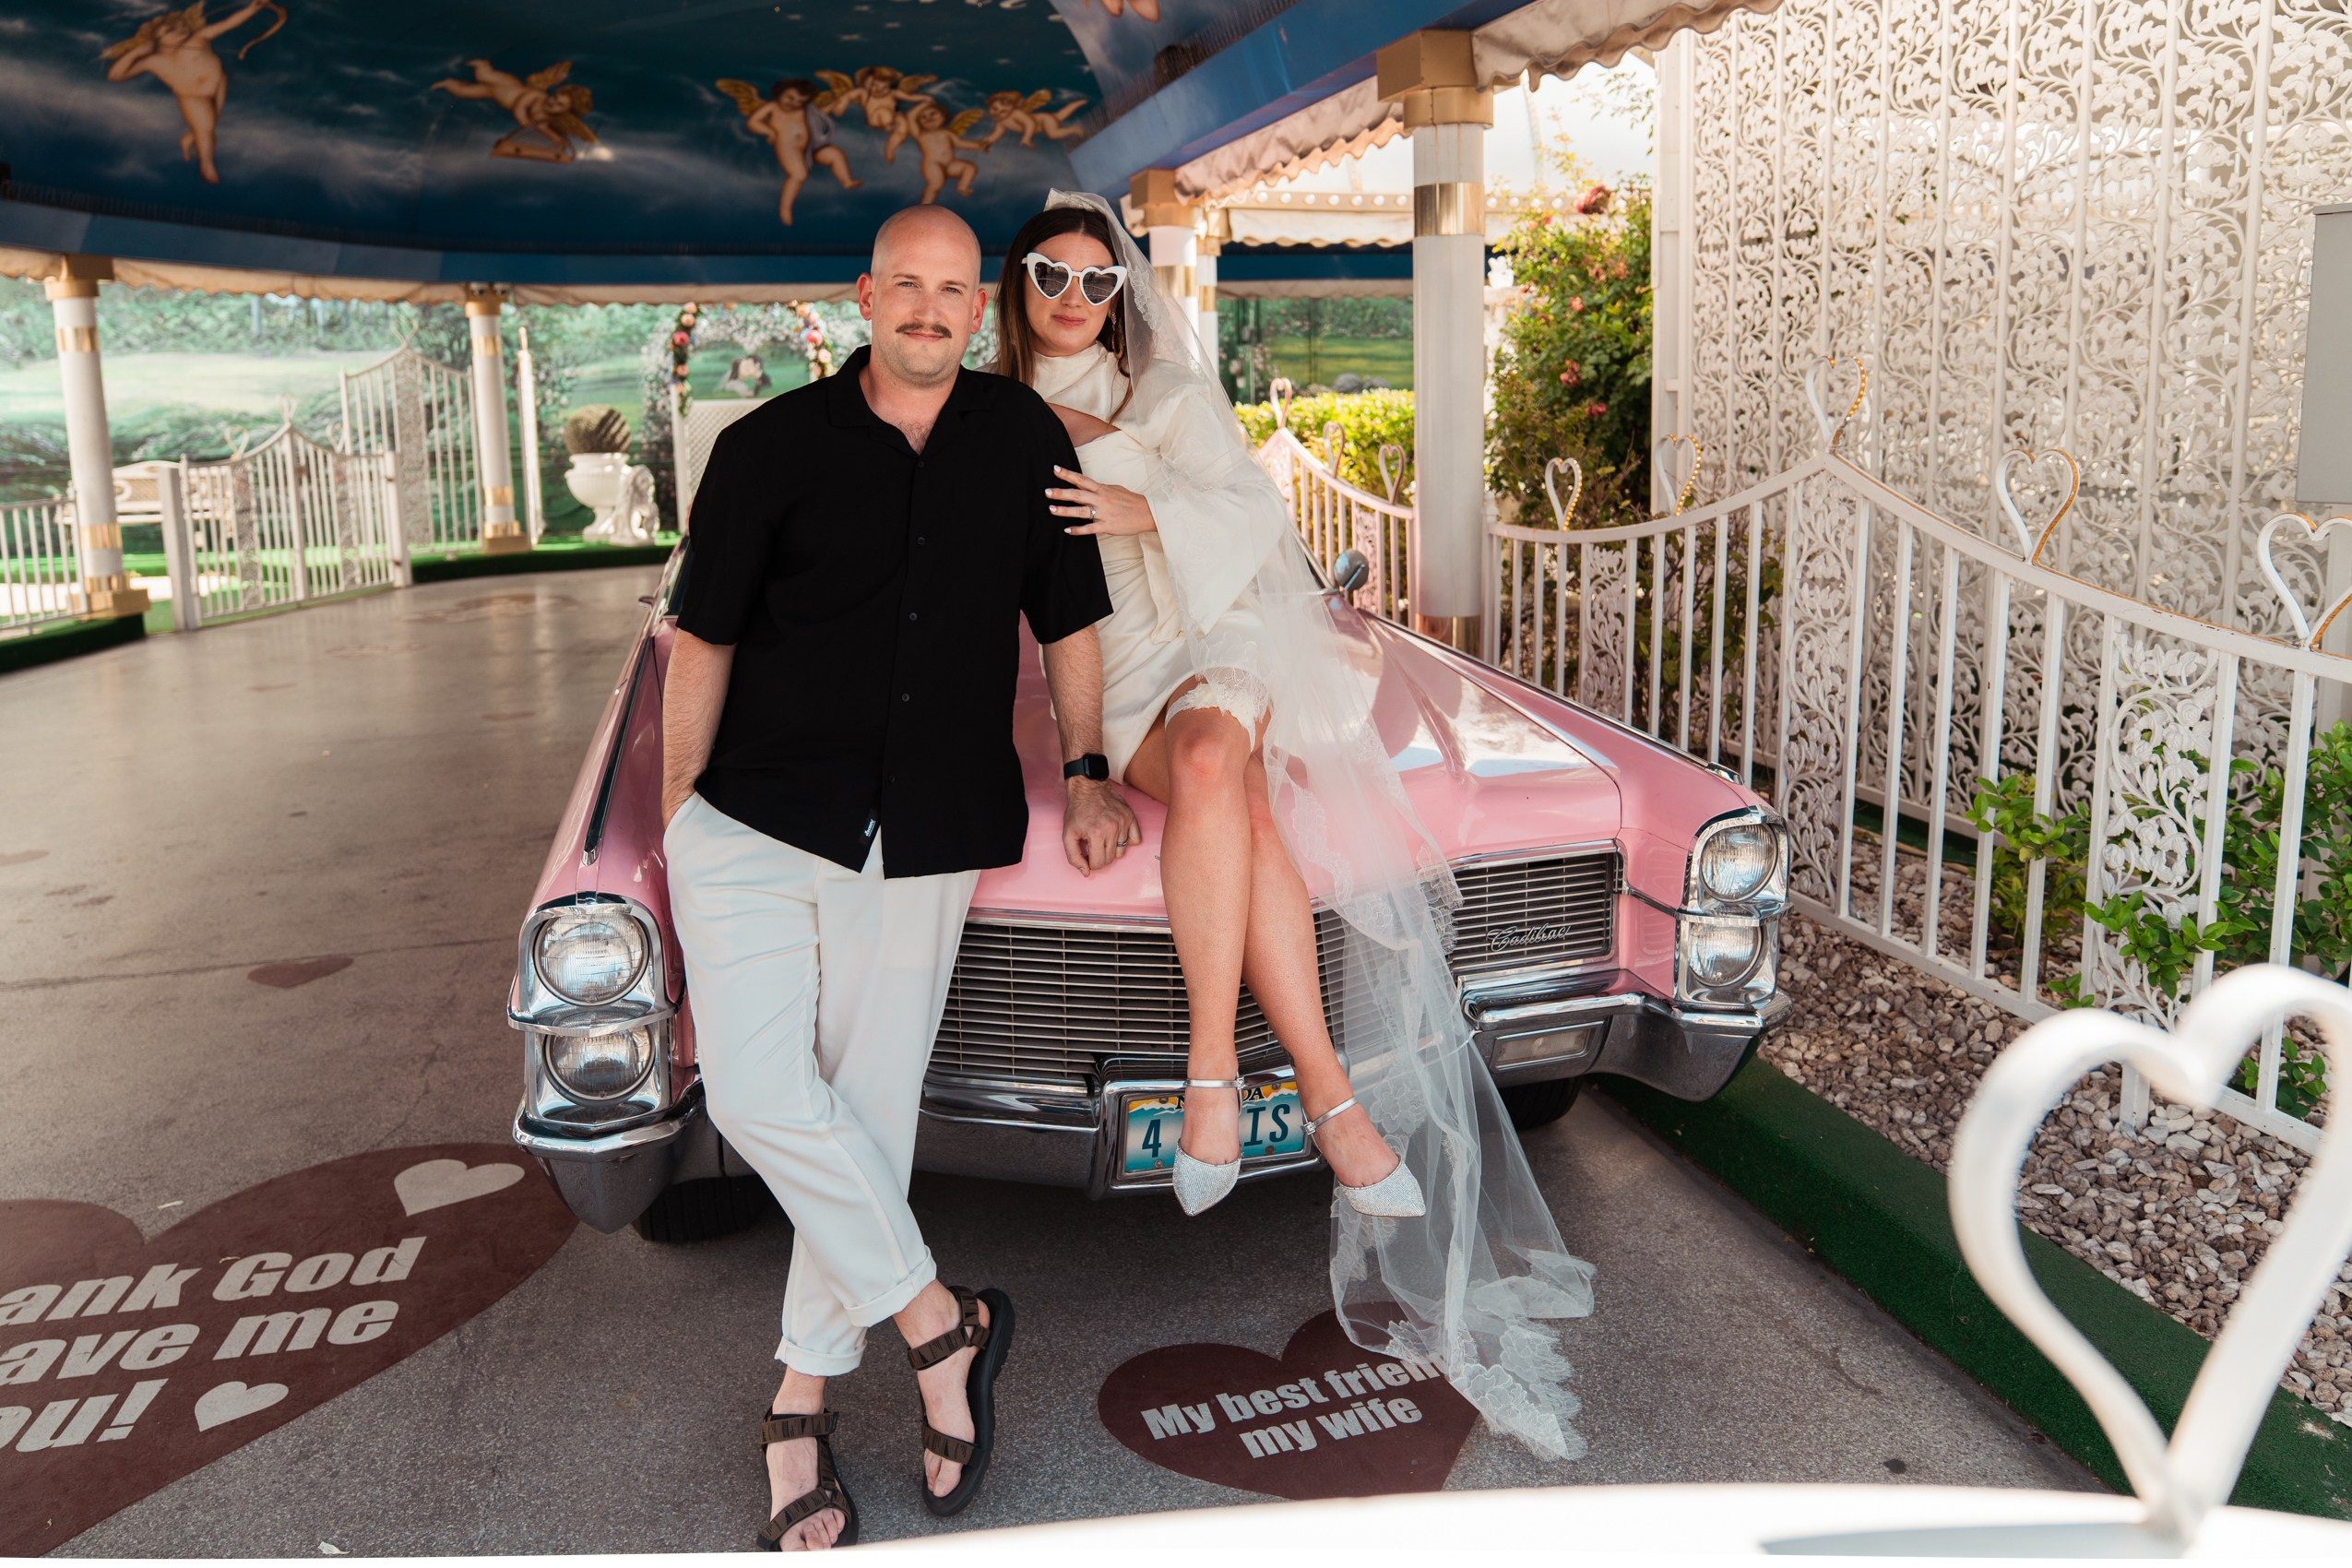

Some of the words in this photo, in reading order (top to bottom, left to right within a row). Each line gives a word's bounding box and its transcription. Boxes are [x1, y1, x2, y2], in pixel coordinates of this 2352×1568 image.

[212, 1236, 427, 1301] God
[212, 1300, 399, 1361] me
[1140, 1401, 1216, 1442] My
[1215, 1377, 1329, 1423] best
[1324, 1353, 1448, 1401] frien
[1238, 1418, 1318, 1460] my
[1314, 1397, 1423, 1442] wife
